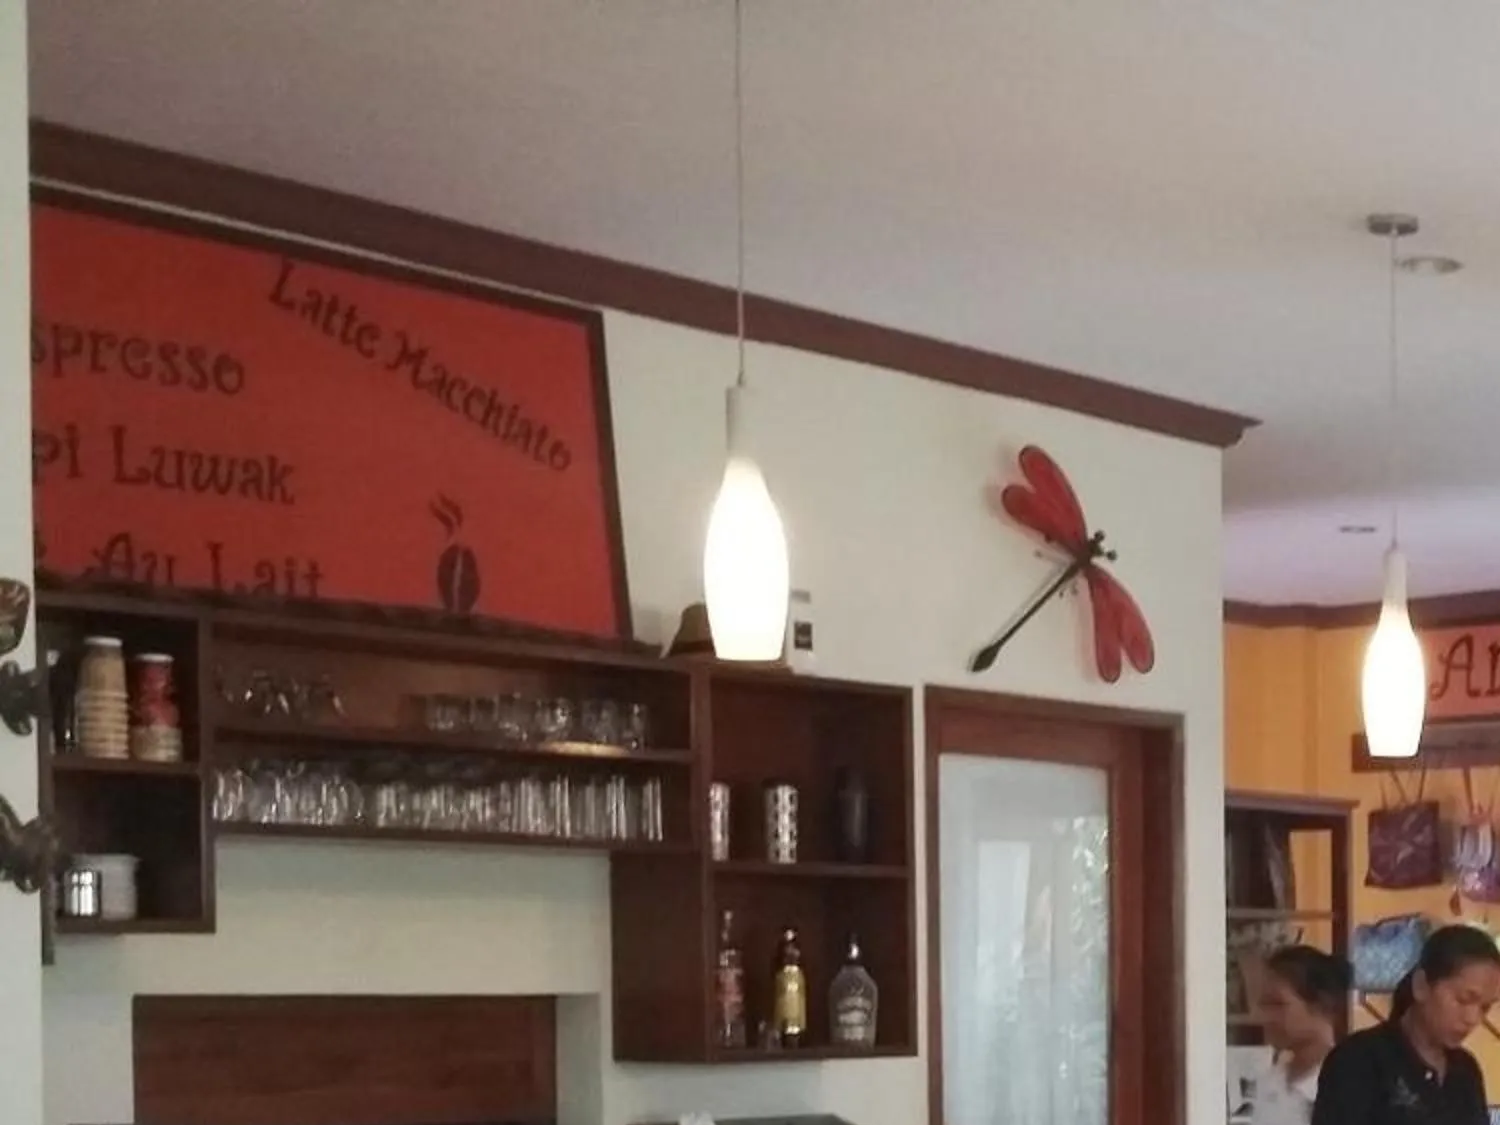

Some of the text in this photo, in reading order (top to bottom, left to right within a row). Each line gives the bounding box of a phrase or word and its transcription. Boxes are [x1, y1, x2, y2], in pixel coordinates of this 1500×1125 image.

[31, 322, 246, 396] spresso
[267, 258, 572, 471] Latte Macchiato
[109, 424, 296, 505] Luwak
